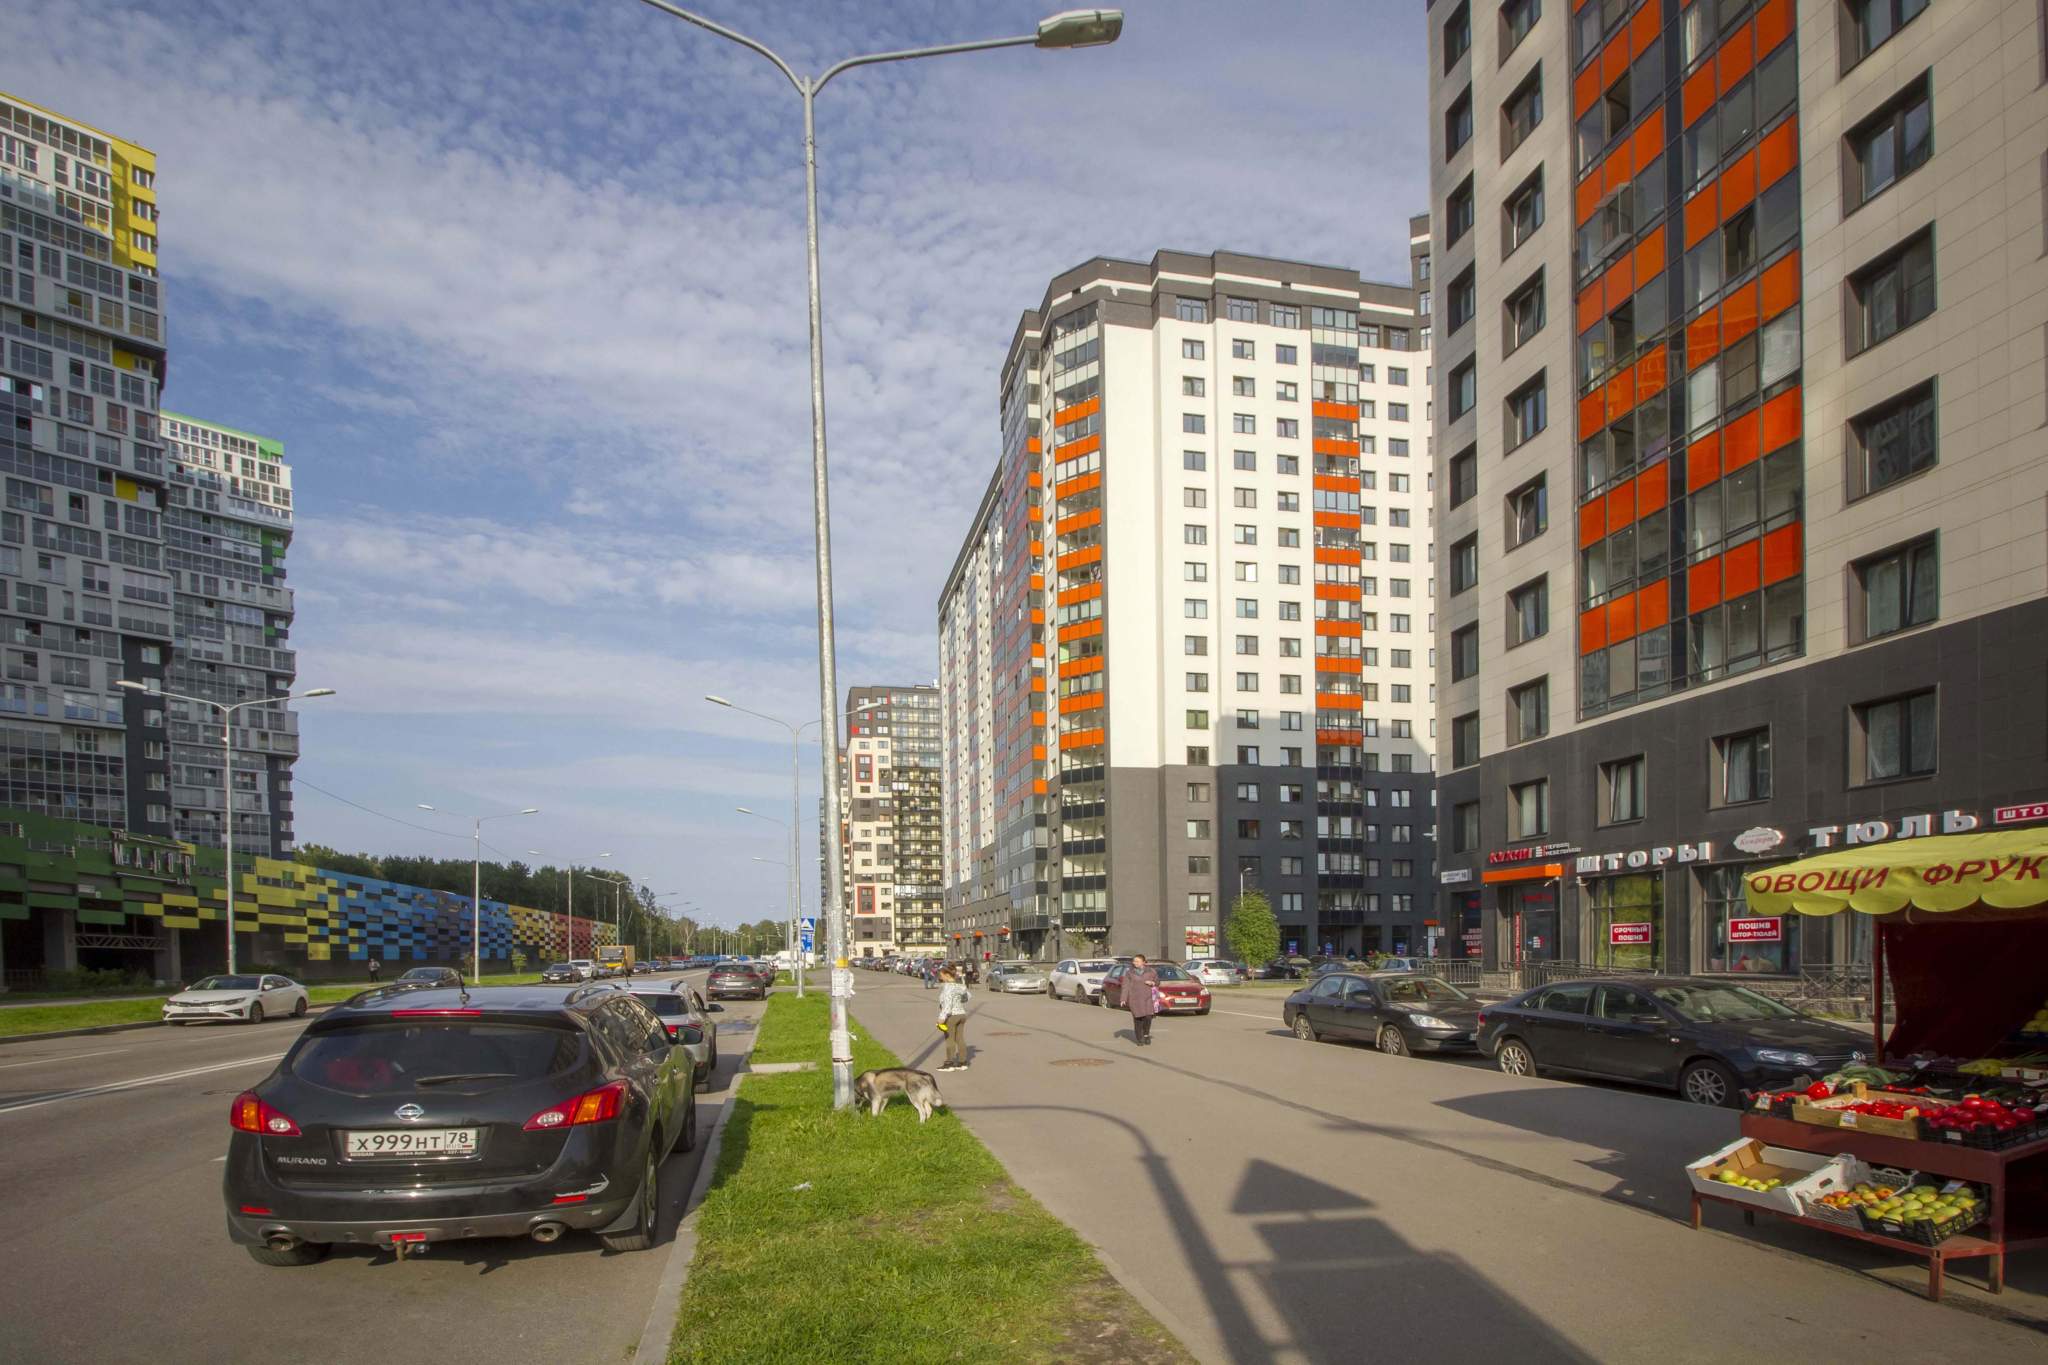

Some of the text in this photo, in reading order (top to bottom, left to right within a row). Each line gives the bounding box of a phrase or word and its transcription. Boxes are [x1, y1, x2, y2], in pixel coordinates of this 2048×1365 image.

[2002, 806, 2048, 819] ШТО
[1808, 810, 1978, 848] ТЮЛЬ
[1488, 847, 1533, 864] КУХНИ
[1576, 842, 1711, 873] ШТОРЫ
[1750, 866, 1890, 894] ОВОЩИ
[1614, 925, 1648, 934] СРОЧНЫЙ
[1738, 922, 1771, 930] ПОШИВ
[447, 1132, 468, 1144] 78
[277, 1156, 327, 1166] MURANO
